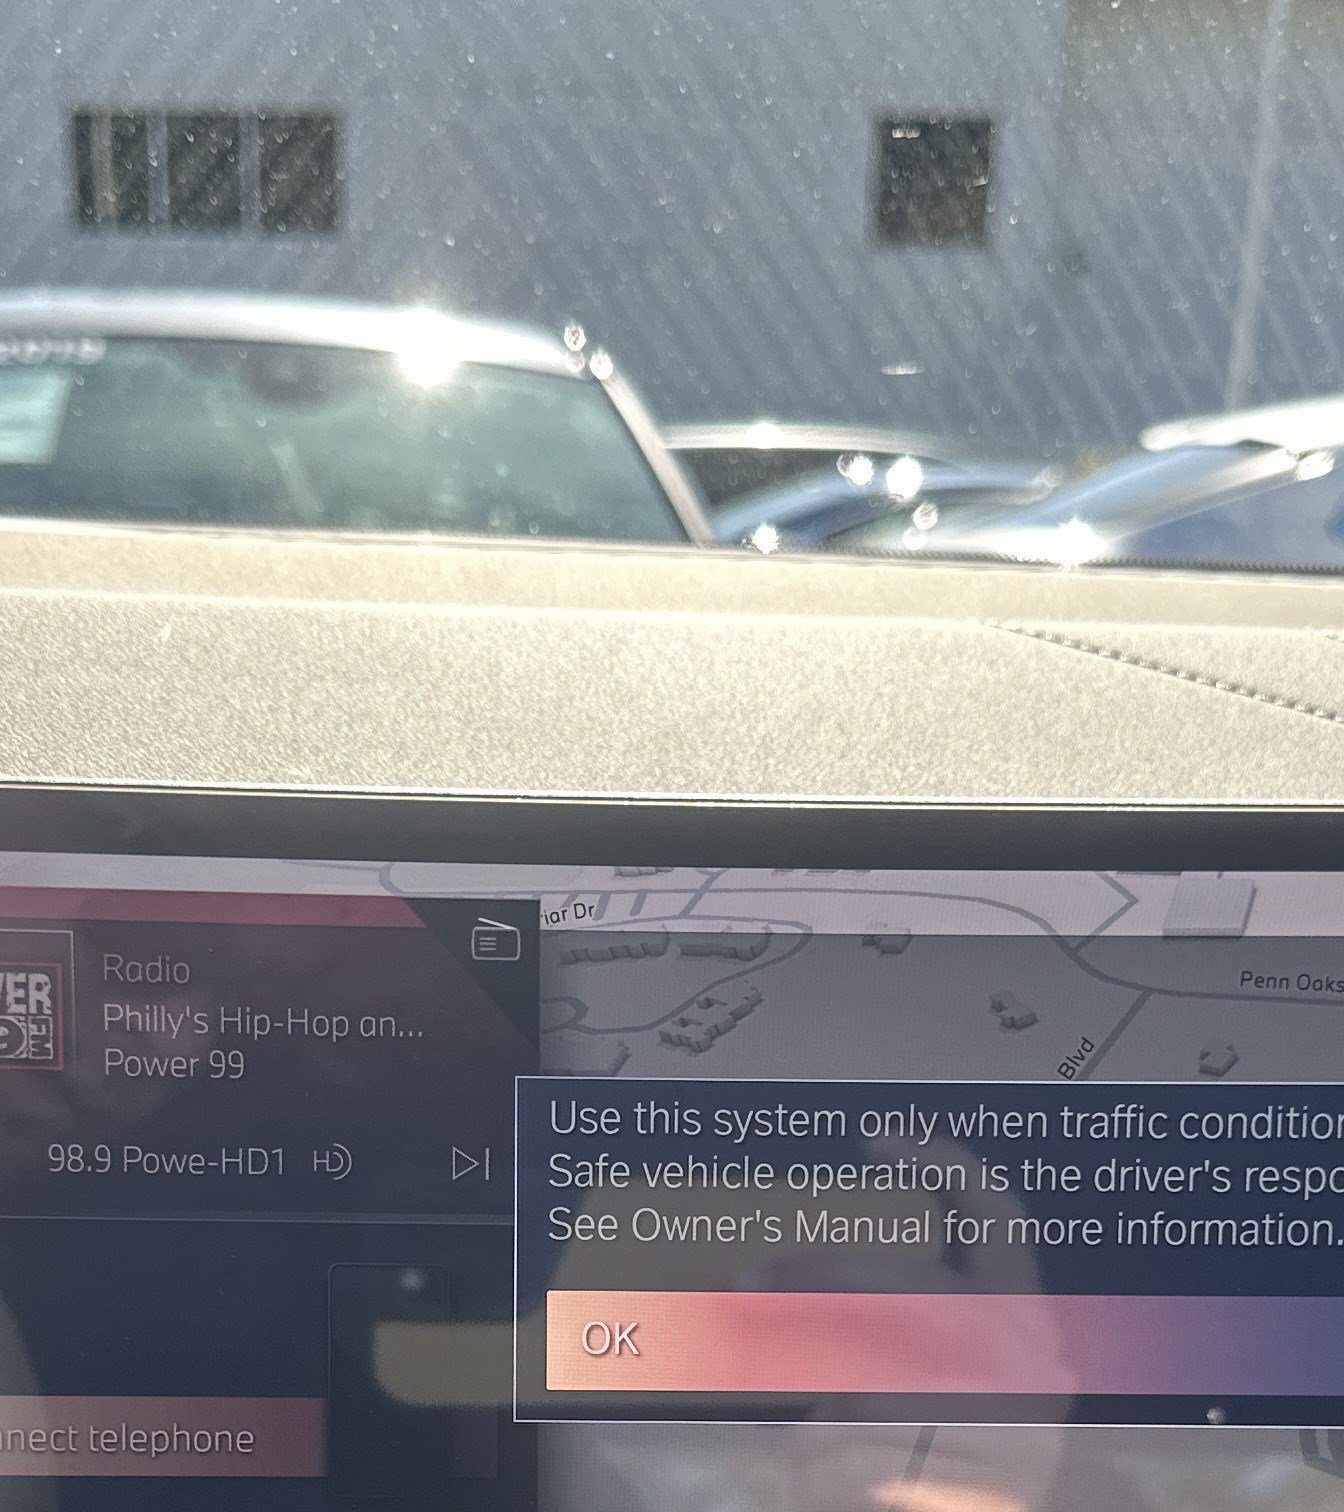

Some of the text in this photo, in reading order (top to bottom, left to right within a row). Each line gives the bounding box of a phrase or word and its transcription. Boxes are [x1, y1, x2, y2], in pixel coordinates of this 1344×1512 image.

[540, 902, 596, 926] iar Dr
[103, 953, 190, 984] Radio
[1240, 970, 1290, 991] Penn
[103, 1003, 424, 1043] Philly's Hip-Hop an...
[104, 1047, 245, 1080] Power 99
[1057, 1036, 1095, 1080] Blvd
[549, 1100, 622, 1136] Use
[633, 1101, 702, 1136] this
[713, 1105, 848, 1143] system
[859, 1103, 939, 1145] only
[947, 1103, 1049, 1139] when
[1060, 1103, 1169, 1139] traffic
[47, 1143, 112, 1174] 98.9
[122, 1144, 285, 1176] Powe-HD1
[548, 1152, 631, 1189] Safe
[642, 1154, 776, 1190] vehicle
[786, 1156, 967, 1197] operation
[979, 1157, 1011, 1192] is
[1020, 1157, 1082, 1193] the
[1093, 1157, 1233, 1193] driver's
[547, 1206, 1344, 1247] See Owner's Manual for more information.
[580, 1321, 640, 1356] OK
[88, 1421, 255, 1456] telephone
